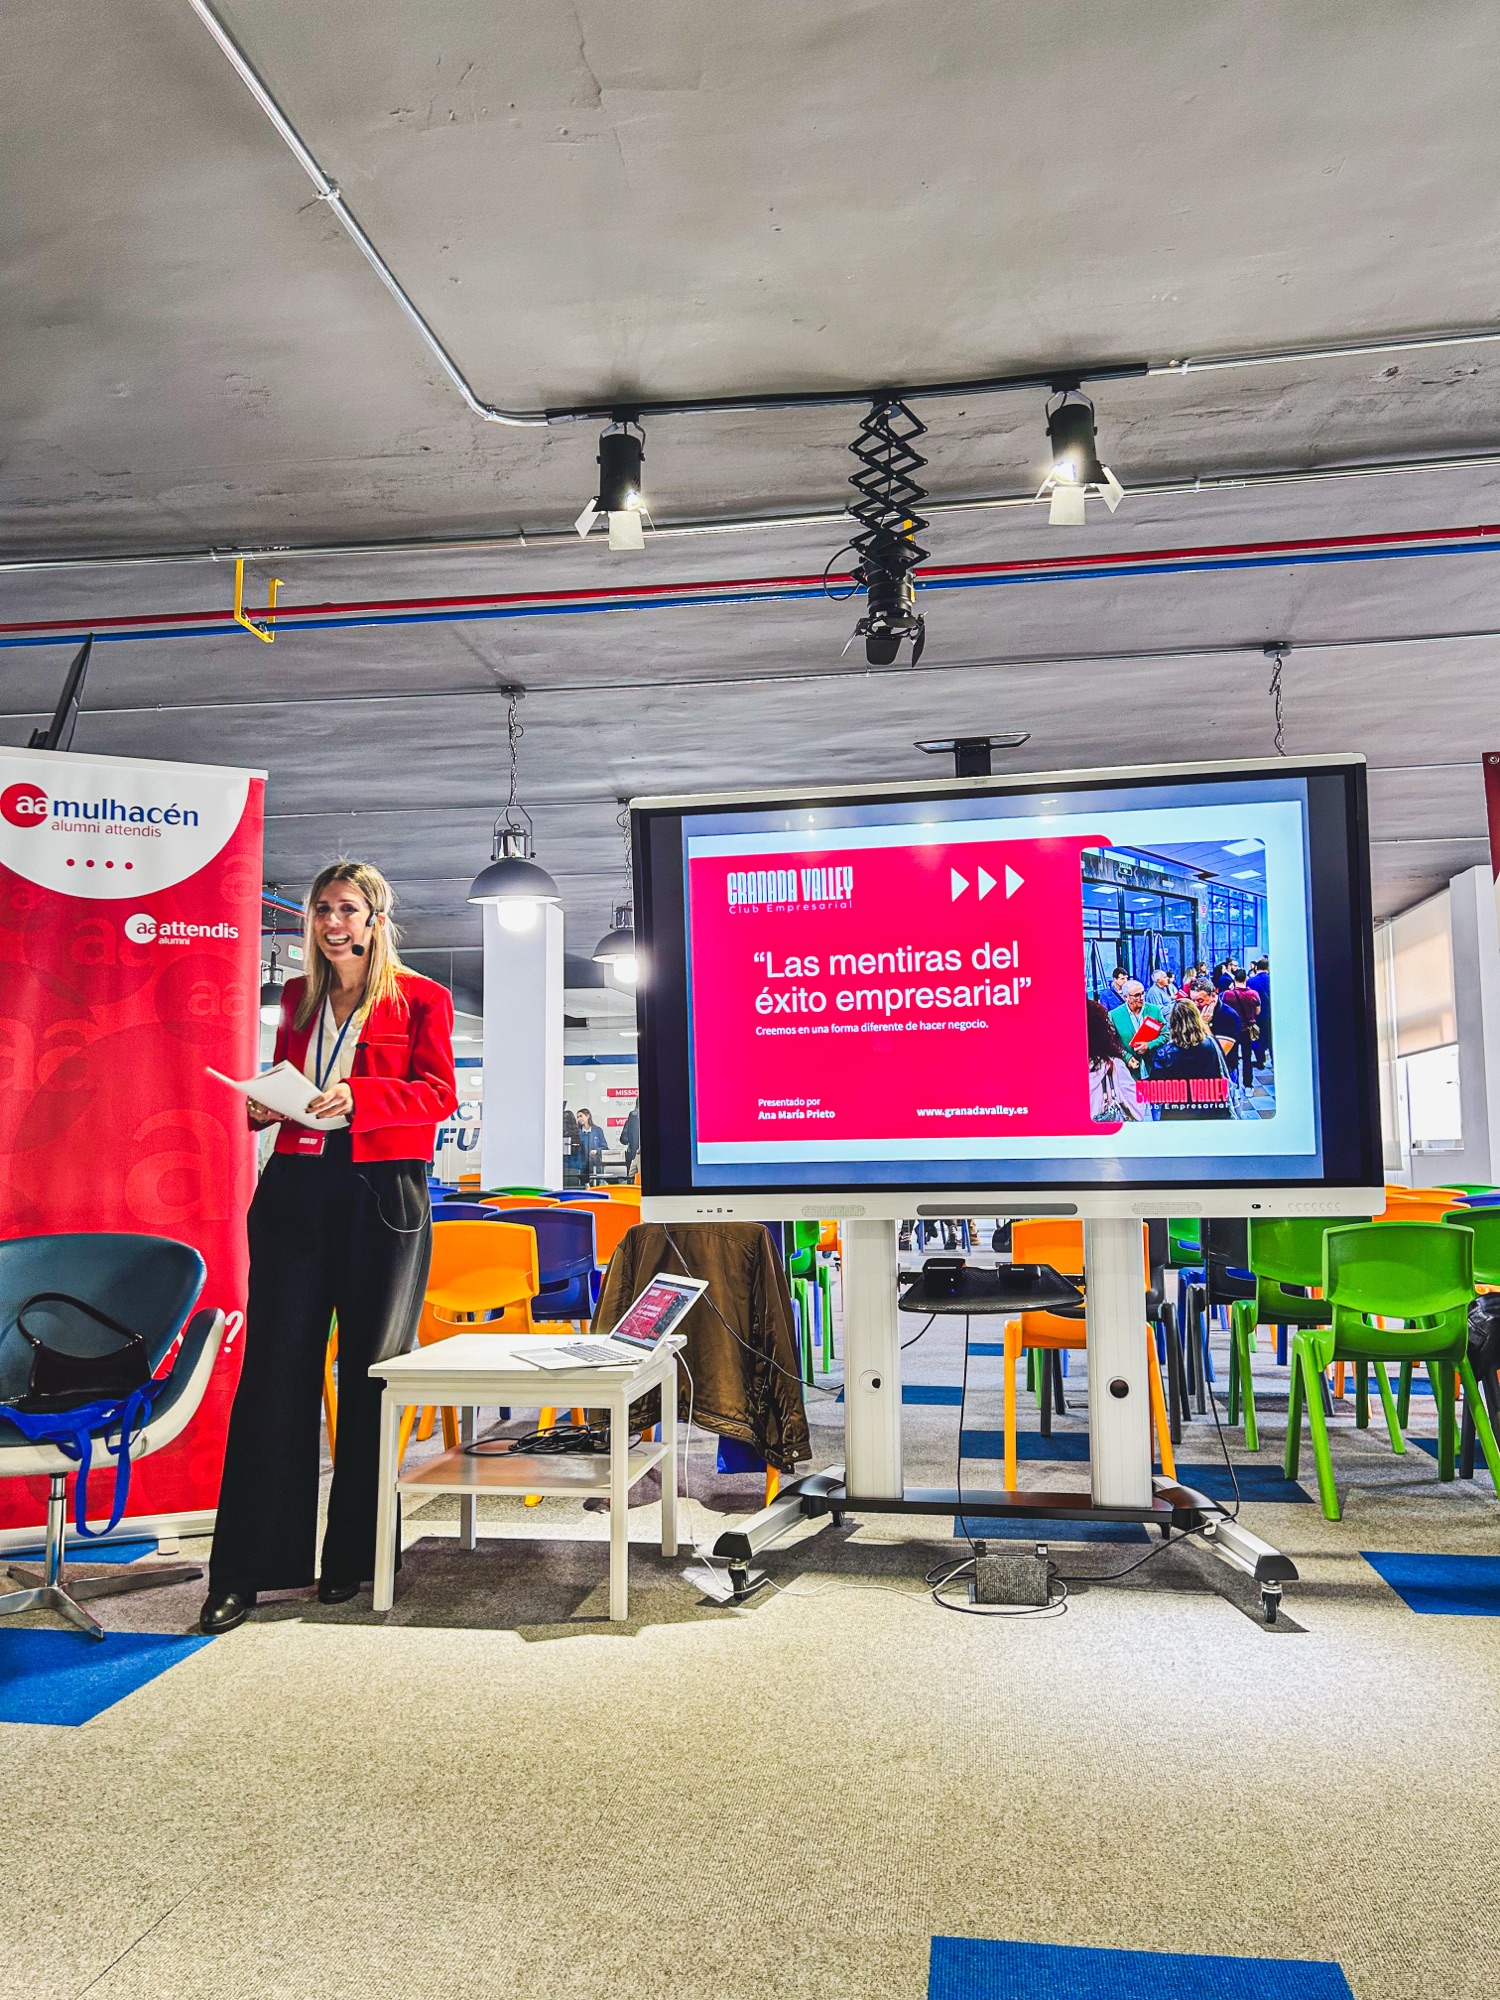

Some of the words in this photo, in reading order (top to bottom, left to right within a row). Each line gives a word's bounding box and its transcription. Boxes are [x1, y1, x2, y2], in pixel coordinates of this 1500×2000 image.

[53, 798, 199, 826] mulhacén
[51, 820, 101, 833] alumni
[105, 824, 162, 838] attendis
[727, 868, 798, 905] GRANADA
[801, 865, 854, 900] VALLEY
[728, 905, 760, 915] Club
[766, 900, 852, 913] Empresarial
[159, 921, 239, 939] attendis
[158, 936, 190, 945] alumni
[829, 945, 962, 976] mentiras
[971, 940, 1019, 970] del
[755, 986, 827, 1015] éxito
[755, 1025, 797, 1036] Creemos
[798, 1025, 810, 1034] en
[812, 1024, 829, 1034] una
[831, 1022, 859, 1033] forma
[861, 1020, 904, 1032] diferente
[906, 1020, 918, 1030] de
[919, 1020, 946, 1031] hacer
[948, 1018, 989, 1032] negocio.
[1136, 1079, 1188, 1104] GRANADA
[758, 1097, 806, 1108] Presentado
[807, 1097, 821, 1109] por
[917, 1104, 1029, 1118] www.granadavalley.es
[1165, 1101, 1230, 1111] Empresarial
[758, 1110, 776, 1120] Ana
[778, 1109, 804, 1120] María
[806, 1109, 836, 1120] Prieto
